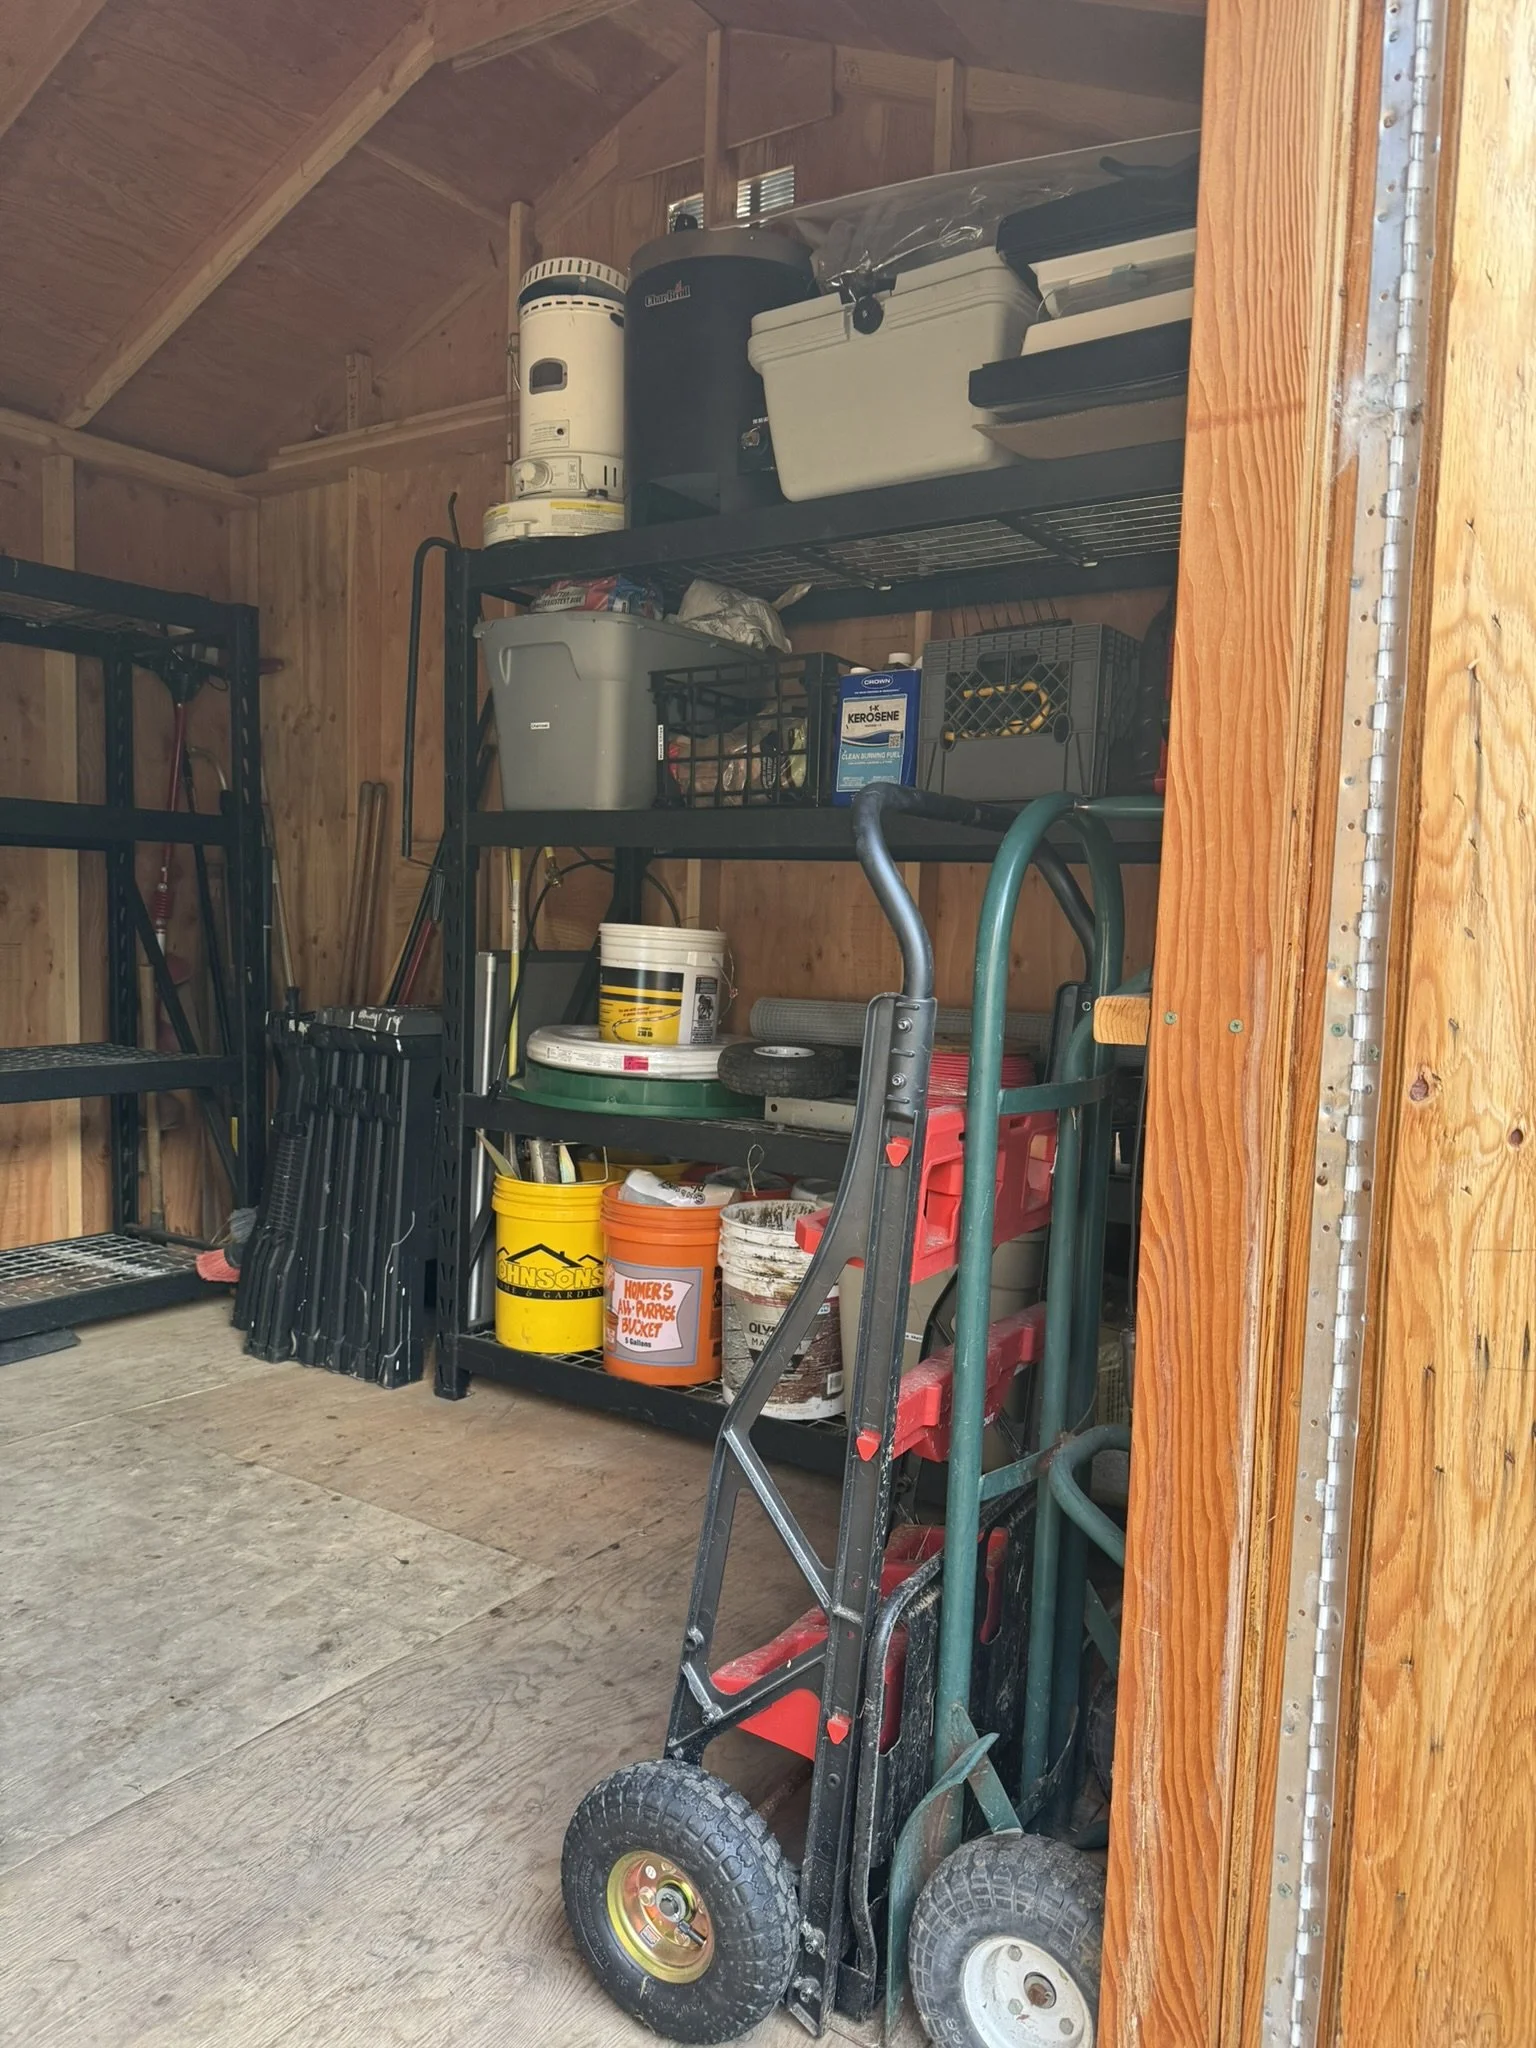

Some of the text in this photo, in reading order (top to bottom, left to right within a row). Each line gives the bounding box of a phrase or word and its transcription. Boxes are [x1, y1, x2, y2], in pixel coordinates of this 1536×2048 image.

[868, 704, 880, 712] 1-K
[847, 710, 900, 724] KEROSENE
[841, 752, 860, 761] CLEAN
[860, 751, 886, 760] BURNING
[497, 1259, 604, 1289] OHNSONS
[624, 1279, 674, 1301] HOMER'S
[621, 1317, 663, 1338] BUCKET
[624, 1336, 652, 1348] 5 Gallons
